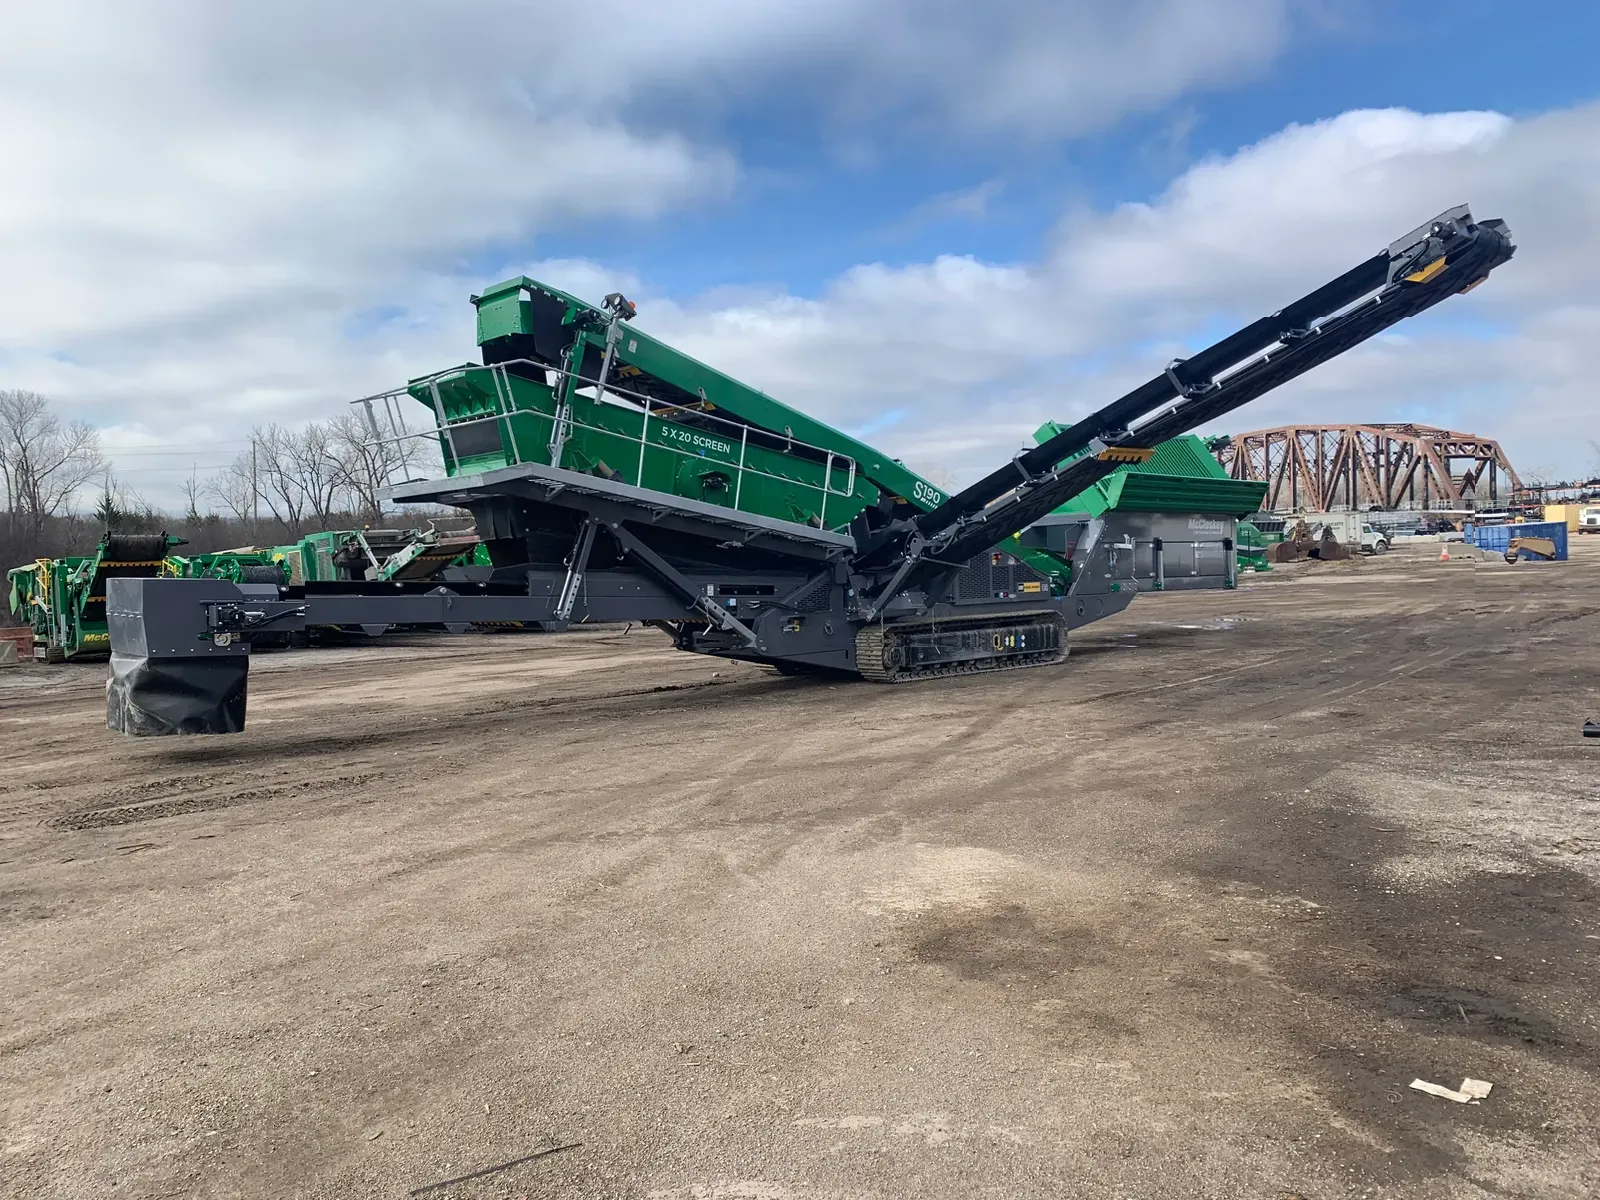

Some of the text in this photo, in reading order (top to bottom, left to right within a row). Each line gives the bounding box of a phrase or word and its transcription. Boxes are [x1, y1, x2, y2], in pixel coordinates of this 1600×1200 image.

[661, 426, 731, 454] 5 X 20 SCREEN
[913, 481, 941, 504] S190
